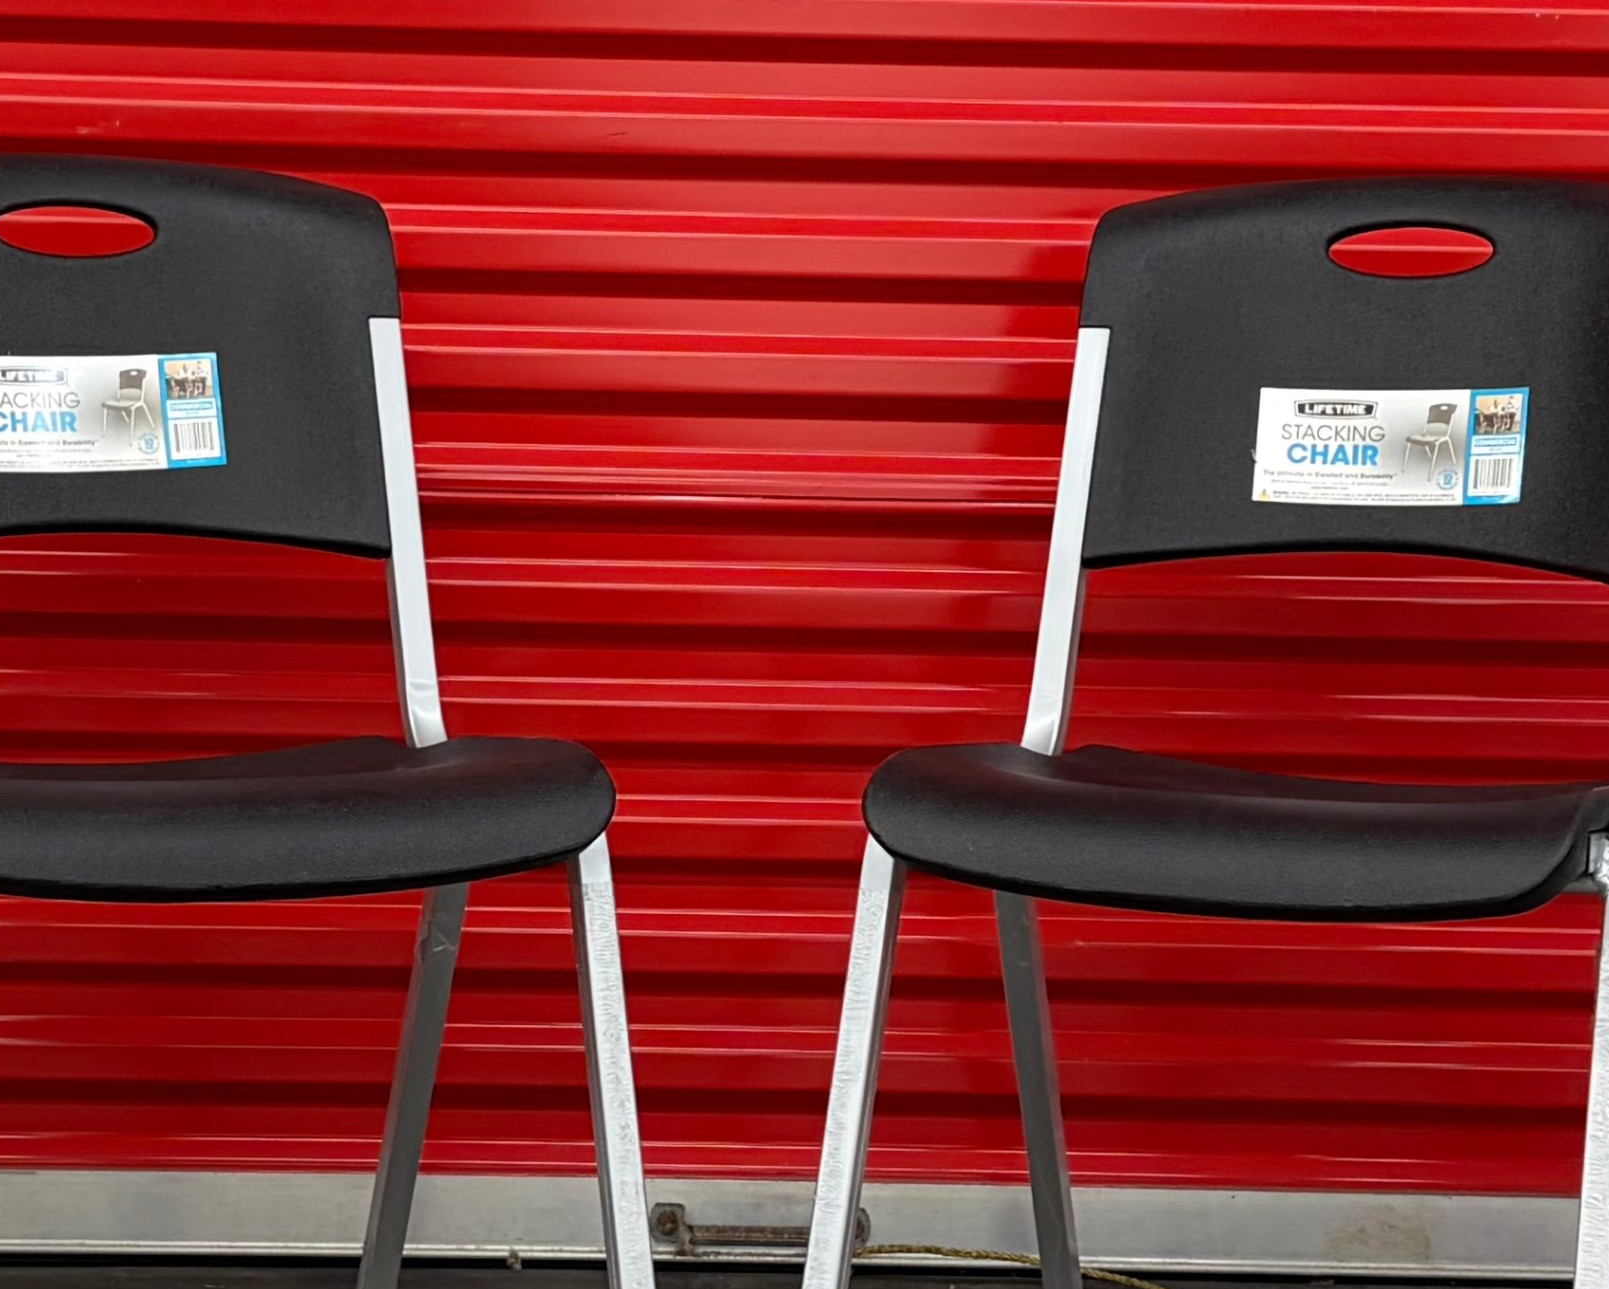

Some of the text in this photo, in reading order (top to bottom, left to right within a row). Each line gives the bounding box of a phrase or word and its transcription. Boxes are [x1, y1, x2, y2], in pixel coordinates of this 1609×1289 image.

[1304, 404, 1367, 415] LIFETIME
[1281, 423, 1386, 442] STACKING
[1286, 442, 1379, 466] CHAIR
